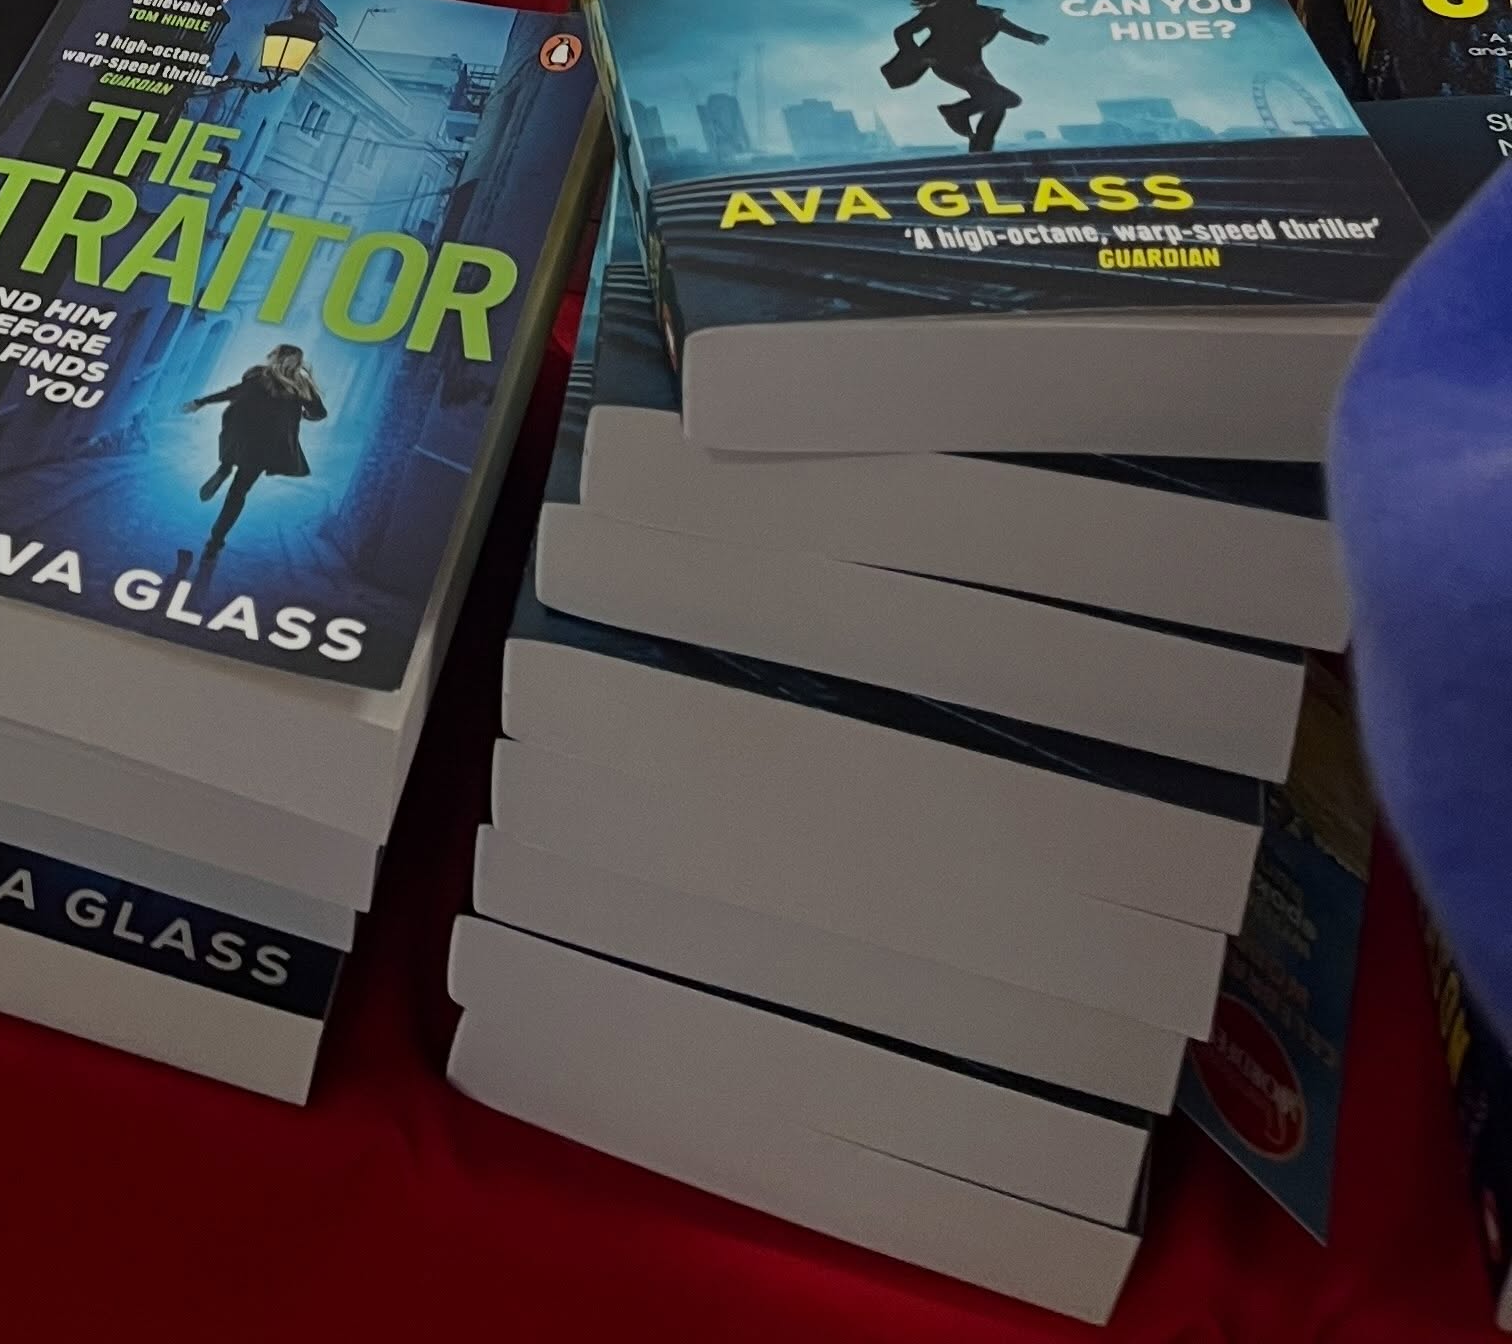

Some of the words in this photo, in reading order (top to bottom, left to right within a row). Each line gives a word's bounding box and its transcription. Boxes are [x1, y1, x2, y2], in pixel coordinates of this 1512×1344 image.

[129, 7, 160, 22] TOM
[161, 15, 212, 33] HINDLE
[1109, 19, 1237, 42] HIDE?
[62, 49, 160, 76] warp-speed
[162, 65, 229, 87] thriller'
[111, 35, 212, 68] high-octane,
[99, 72, 174, 96] GUARDIAN
[75, 99, 242, 196] THE
[718, 183, 893, 231] AVA
[915, 173, 1196, 218] GLASS
[936, 223, 1109, 252] high-octane,
[1113, 219, 1275, 246] warp-speed
[1280, 217, 1380, 242] thriller'
[1097, 246, 1221, 271] GUARDIAN
[44, 299, 117, 330] HIM
[0, 342, 110, 382] FINDS
[26, 374, 105, 408] YOU
[112, 565, 369, 664] GLASS
[63, 887, 295, 990] GLASS
